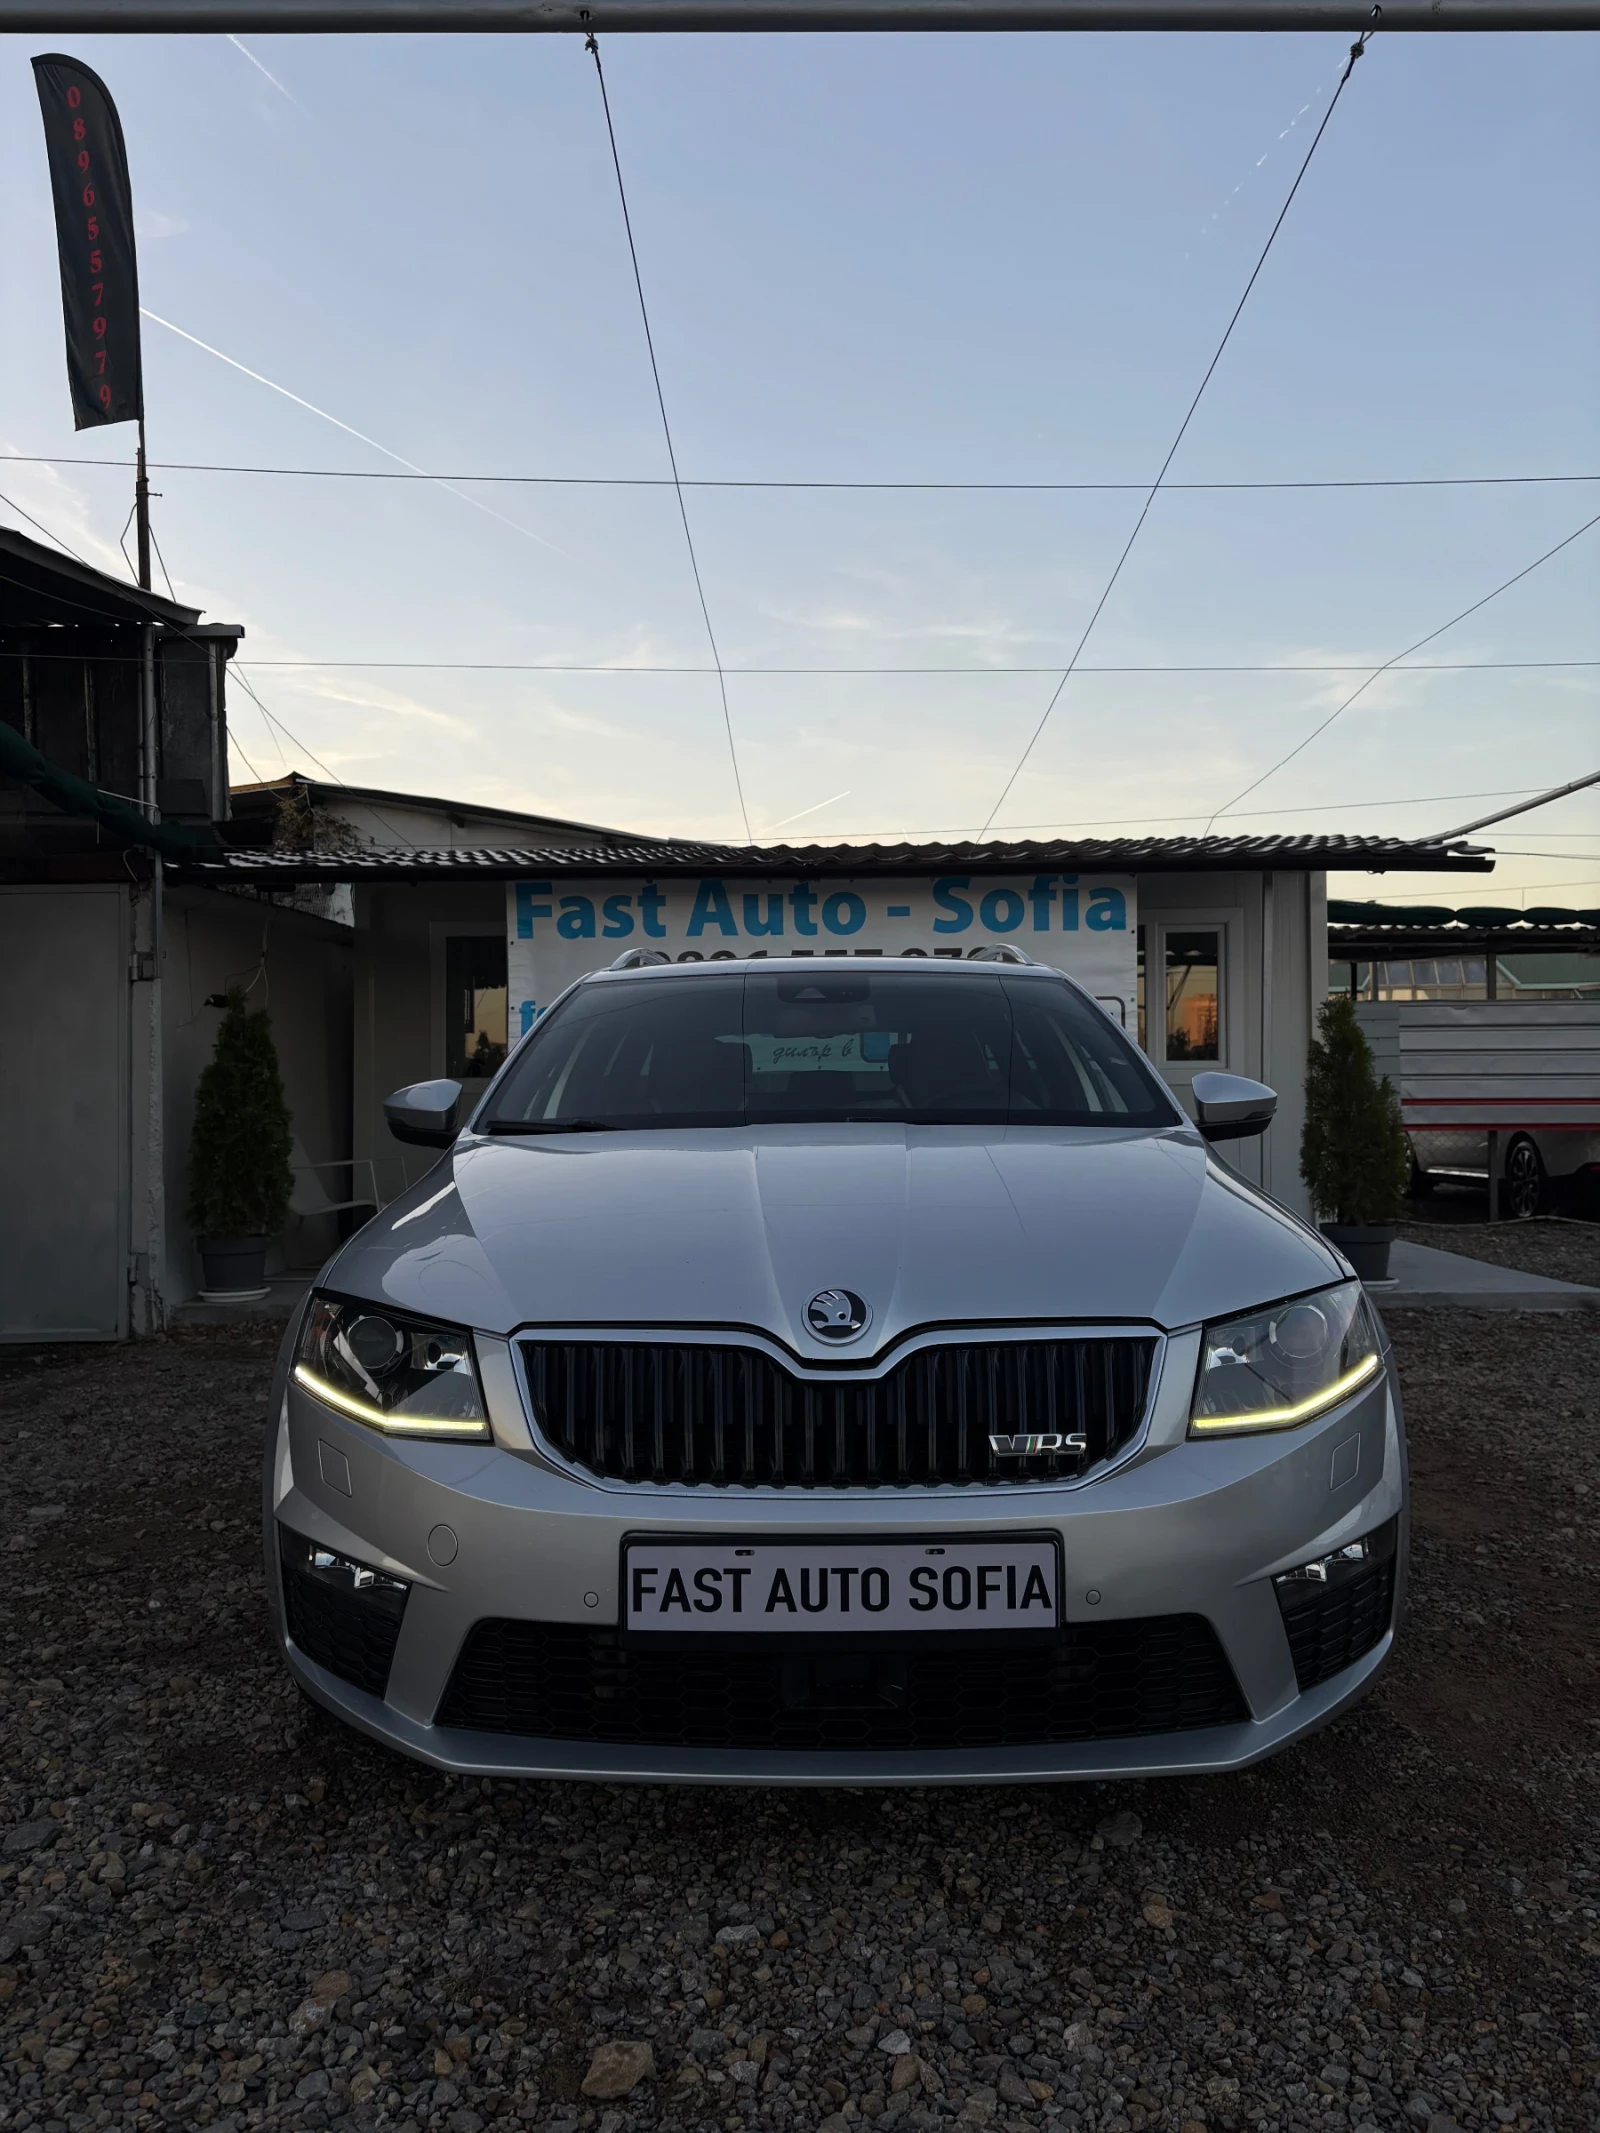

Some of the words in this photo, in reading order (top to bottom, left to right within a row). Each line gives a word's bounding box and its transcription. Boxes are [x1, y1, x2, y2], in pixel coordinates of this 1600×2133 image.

[66, 85, 112, 410] 0896557979
[515, 881, 667, 940] Fast
[686, 879, 867, 937] Auto
[932, 875, 1127, 934] Sofia
[632, 1567, 752, 1613] FAST
[764, 1567, 891, 1613] AUTO
[908, 1564, 1053, 1611] SOFIA
